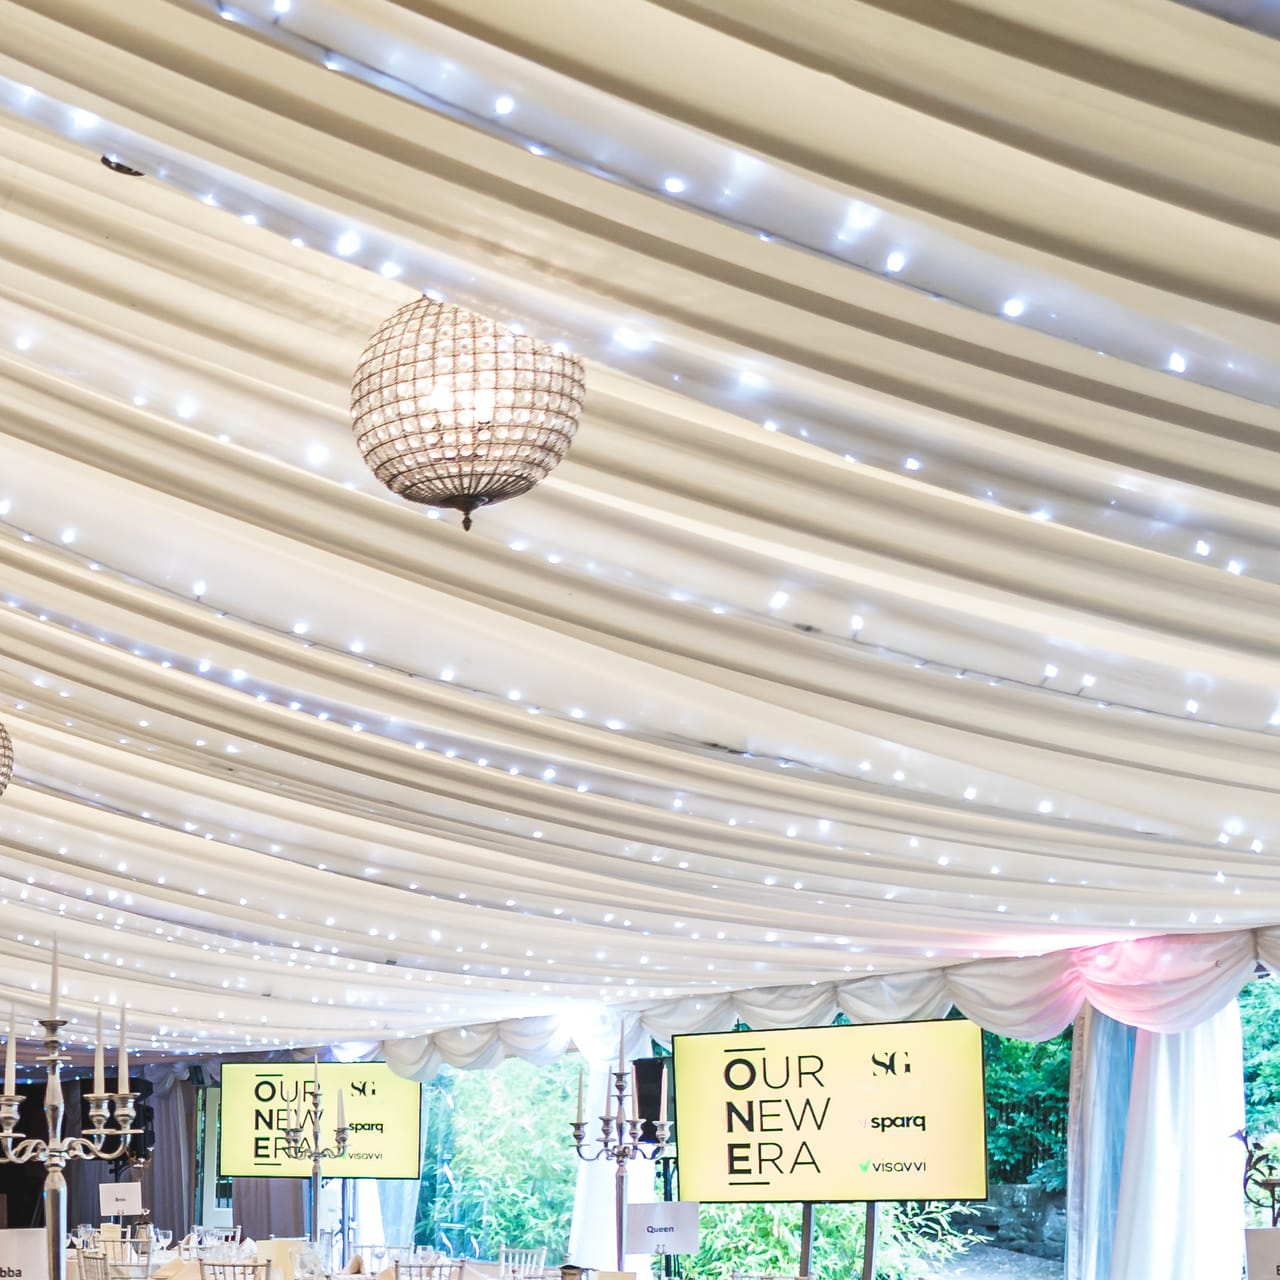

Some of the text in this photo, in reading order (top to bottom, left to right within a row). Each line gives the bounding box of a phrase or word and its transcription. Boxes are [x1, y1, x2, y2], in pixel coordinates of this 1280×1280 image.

[724, 1055, 825, 1090] OUR
[255, 1081, 321, 1102] OUR
[255, 1109, 323, 1130] NEW
[726, 1097, 831, 1132] NEW
[871, 1116, 926, 1132] sparq
[349, 1122, 383, 1133] sparq
[728, 1141, 821, 1174] ERA
[872, 1159, 926, 1172] visavvi
[646, 1225, 675, 1233] Queen
